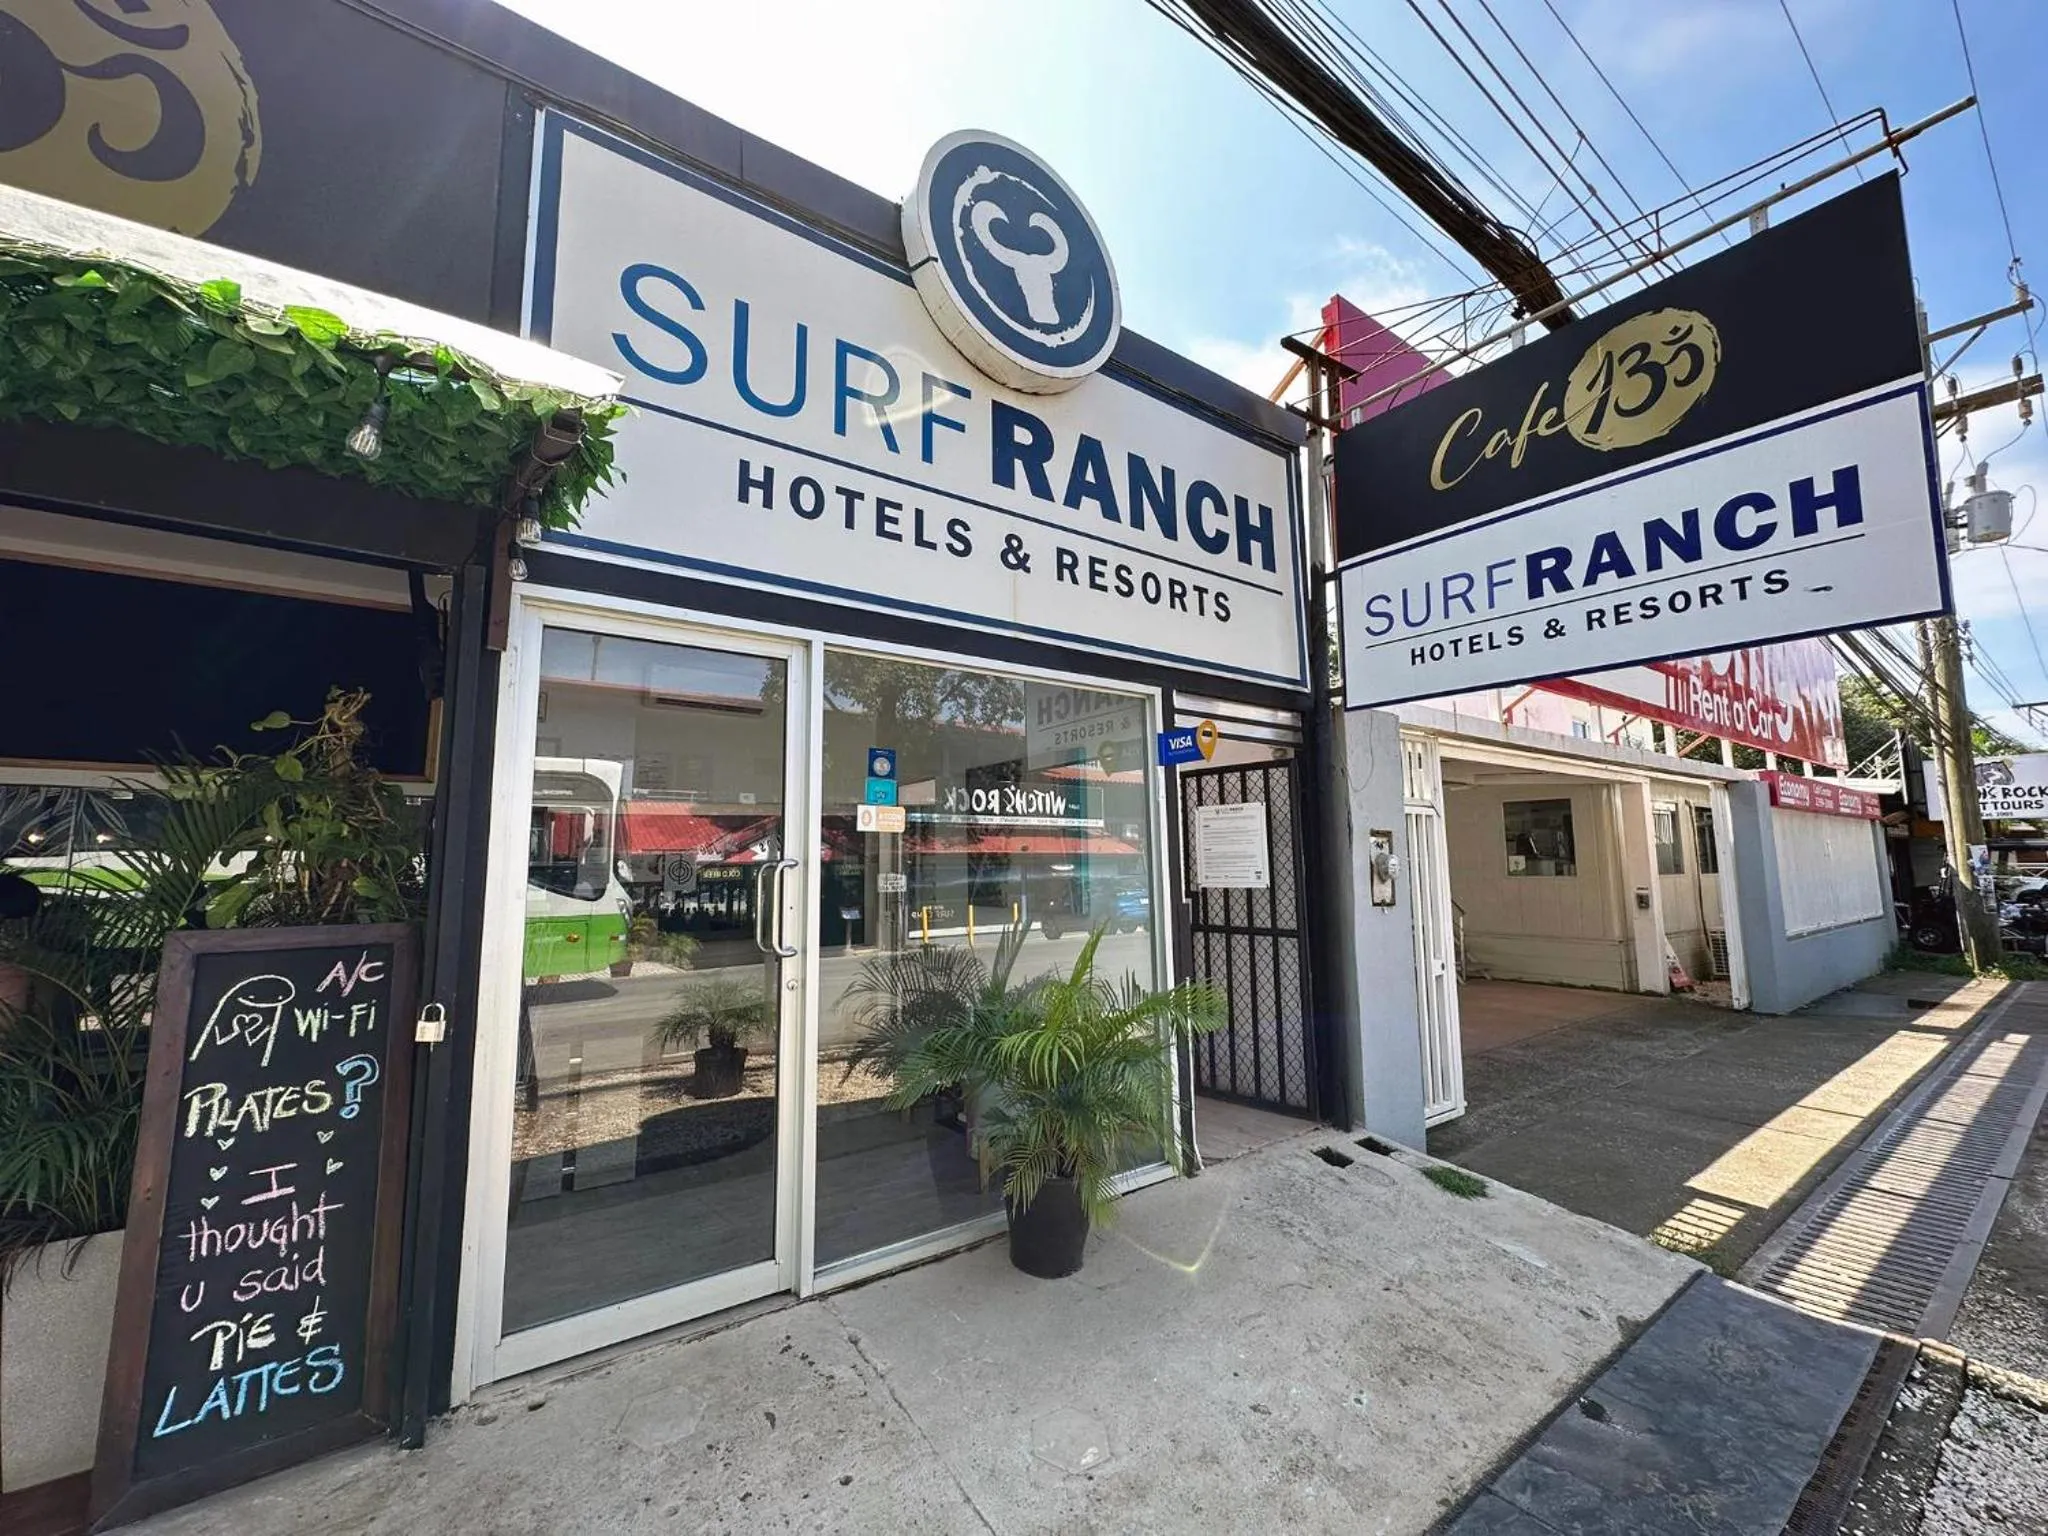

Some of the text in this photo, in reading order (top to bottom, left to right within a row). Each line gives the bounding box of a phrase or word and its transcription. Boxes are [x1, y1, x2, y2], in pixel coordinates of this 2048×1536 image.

[1430, 381, 1562, 491] Cafe
[737, 458, 1232, 623] HOTELS & RESORTS
[1410, 568, 1791, 666] HOTELS & RESORTS
[1689, 674, 1731, 728] Rent
[1733, 700, 1745, 731] a
[1747, 697, 1774, 741] Car
[1168, 735, 1193, 750] VISA
[1991, 799, 2045, 811] TOURS
[2001, 785, 2048, 799] ROCK
[315, 950, 385, 998] A/C
[294, 999, 378, 1043] Wi-Fi
[241, 1162, 298, 1205] I
[177, 1191, 345, 1262] thought
[232, 1245, 328, 1302] said
[152, 1343, 344, 1438] LATTES
